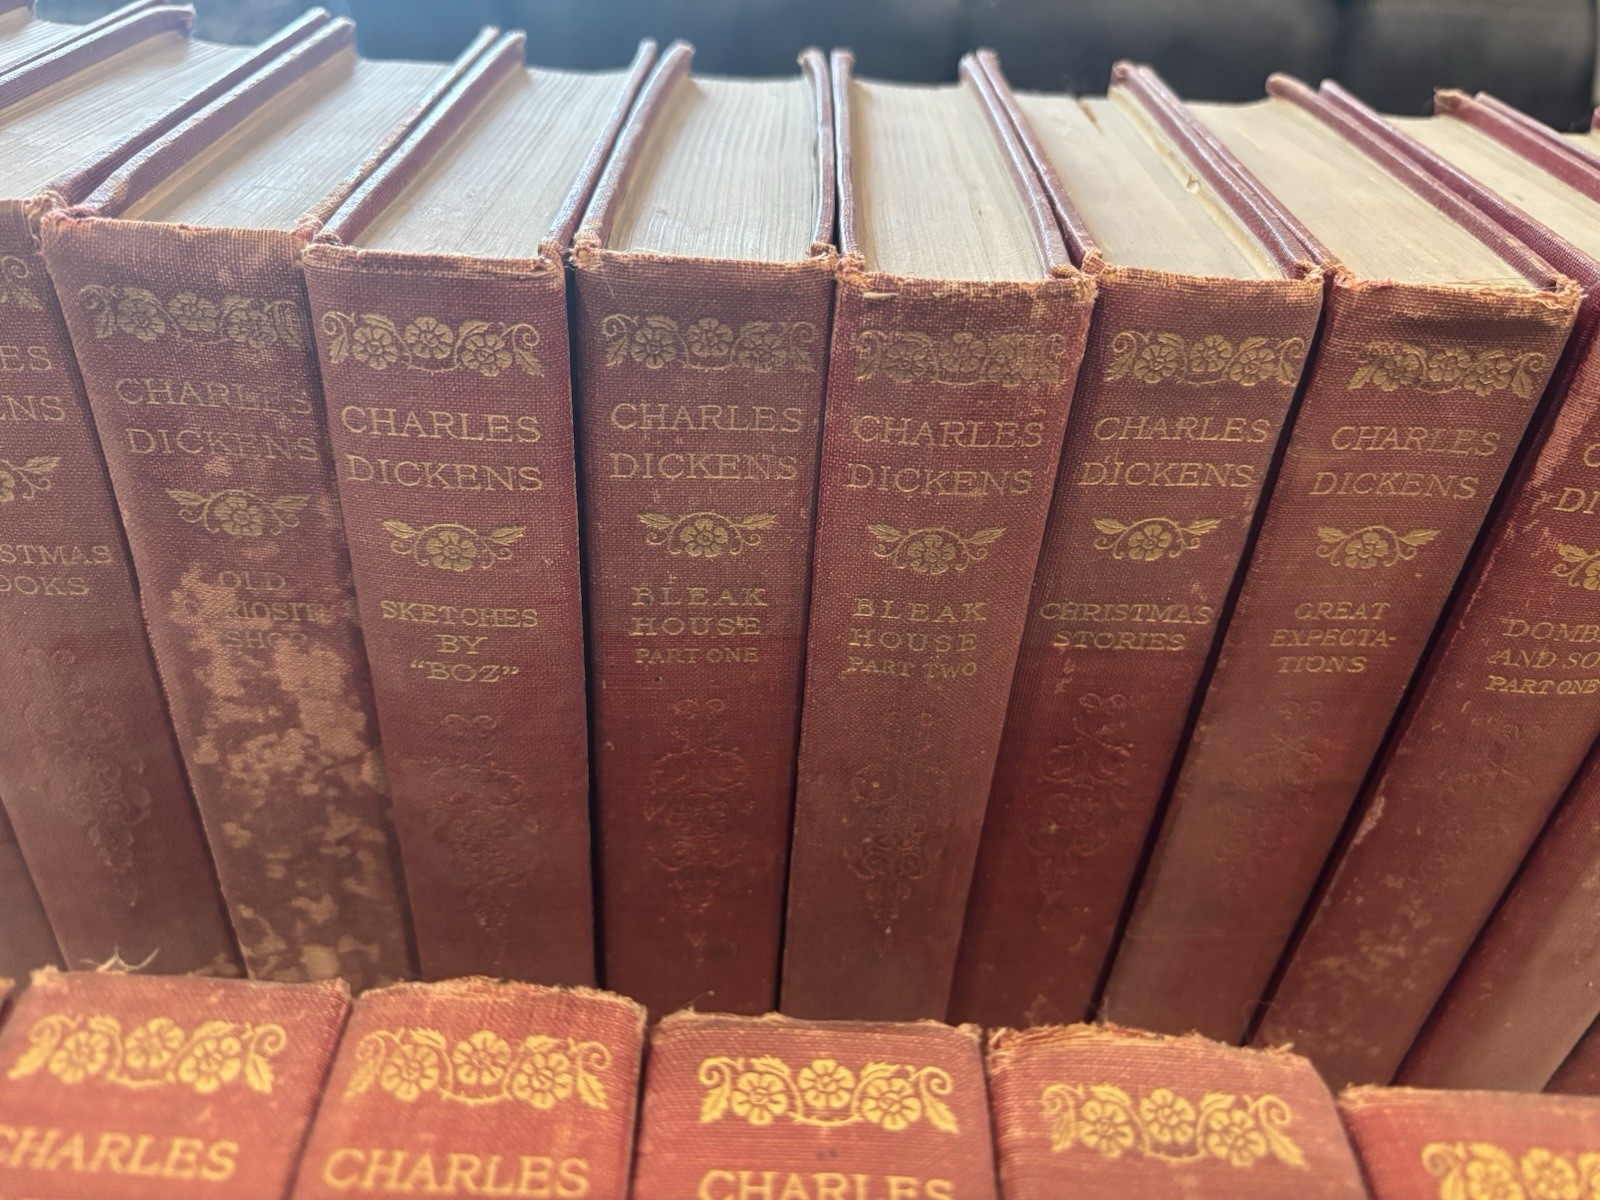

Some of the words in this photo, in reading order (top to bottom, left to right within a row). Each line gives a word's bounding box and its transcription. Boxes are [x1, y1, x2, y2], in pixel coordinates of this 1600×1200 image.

[340, 405, 541, 443] CHARLES
[610, 402, 803, 433] CHARLES
[1094, 415, 1271, 442] CHARLES
[853, 414, 1045, 448] CHARLES
[1331, 425, 1501, 457] CHARLES
[125, 428, 318, 460] DICKENS
[345, 453, 543, 491] DICKENS
[608, 452, 798, 480] DICKENS
[1077, 462, 1256, 488] DICKENS
[846, 463, 1034, 495] DICKENS
[1310, 471, 1480, 499] DICKENS
[218, 571, 287, 591] OLD
[631, 587, 769, 607] BLEAK
[380, 600, 539, 628] SKETCHES
[852, 598, 987, 623] BLEAK
[1039, 602, 1214, 625] CHRISTMAS
[1293, 600, 1391, 620] GREAT
[629, 616, 762, 637] HOUSE
[1270, 628, 1397, 647] EXPECTA-
[436, 634, 488, 655] BY
[848, 628, 979, 652] HOUSE
[1053, 631, 1187, 651] STORIES
[635, 648, 701, 664] PART
[705, 648, 760, 664] ONE
[847, 656, 914, 678] PART
[922, 661, 978, 679] TWO
[1277, 656, 1368, 673] TIONS
[1487, 647, 1557, 668] AND
[1485, 674, 1555, 695] PART
[1557, 679, 1600, 695] ONE
[321, 1148, 590, 1199] CHARLES
